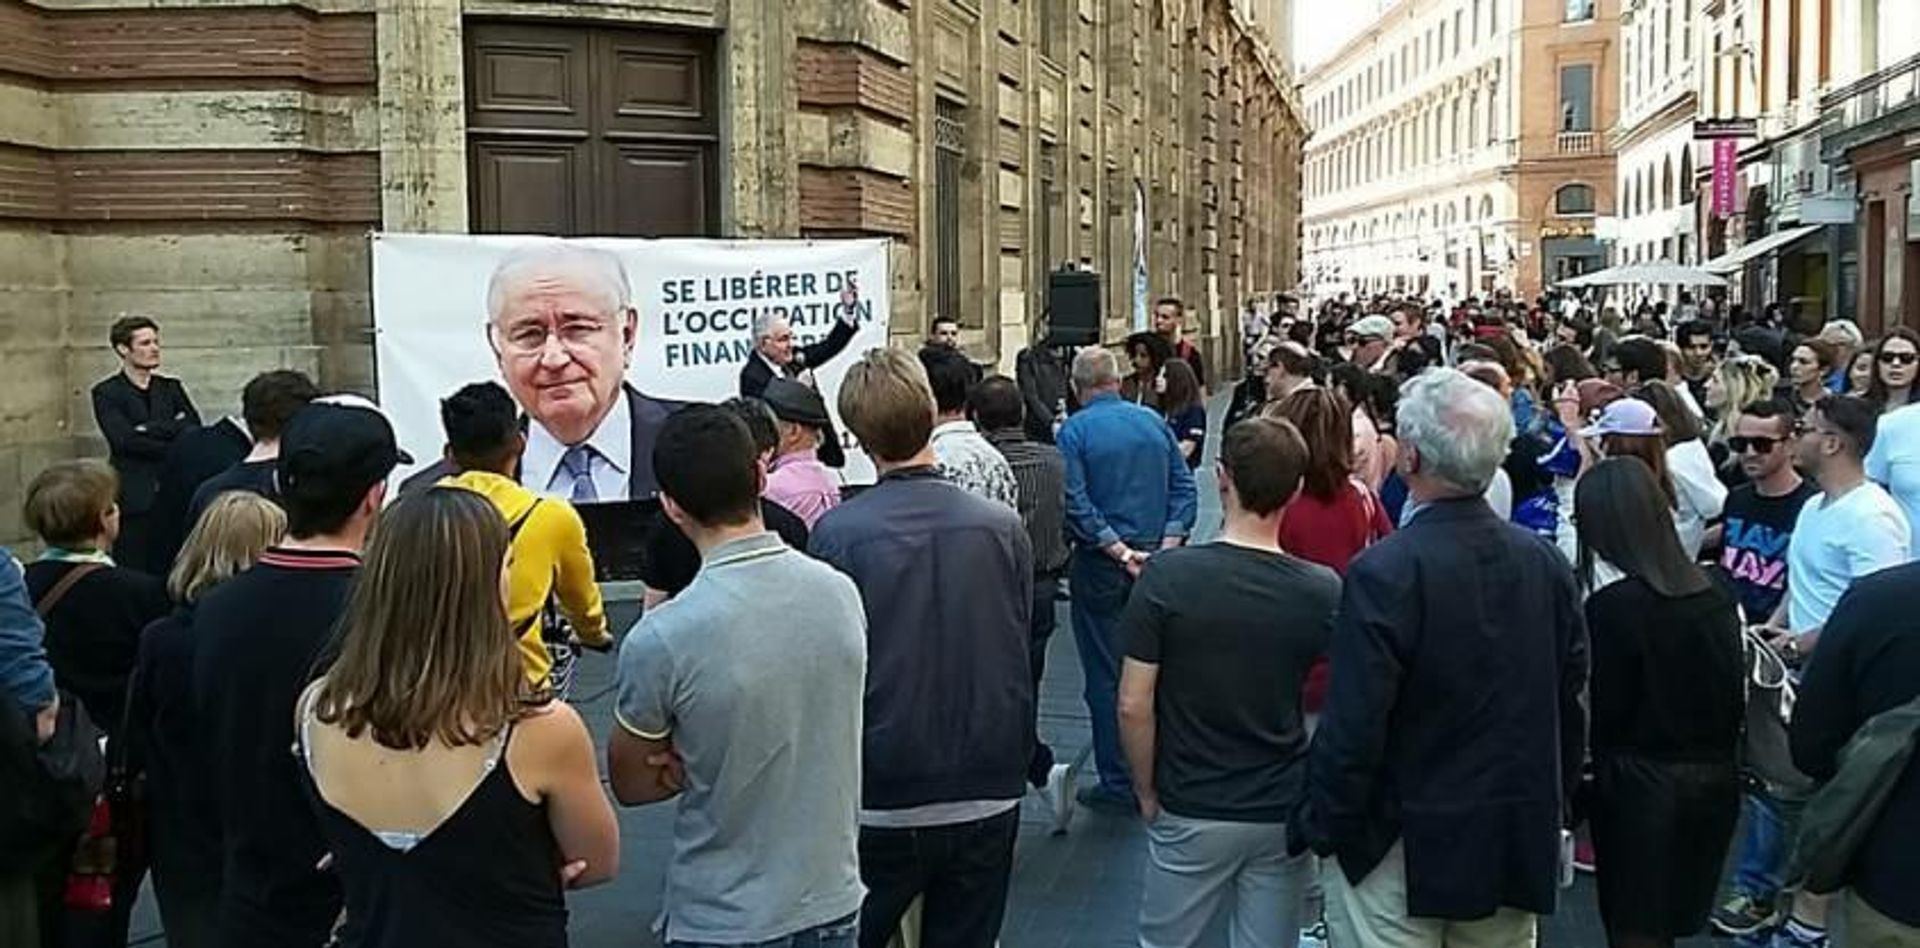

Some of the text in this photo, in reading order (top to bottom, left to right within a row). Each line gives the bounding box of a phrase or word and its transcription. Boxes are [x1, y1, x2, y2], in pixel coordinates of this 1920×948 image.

[662, 270, 859, 304] SE LIBÉRER DE
